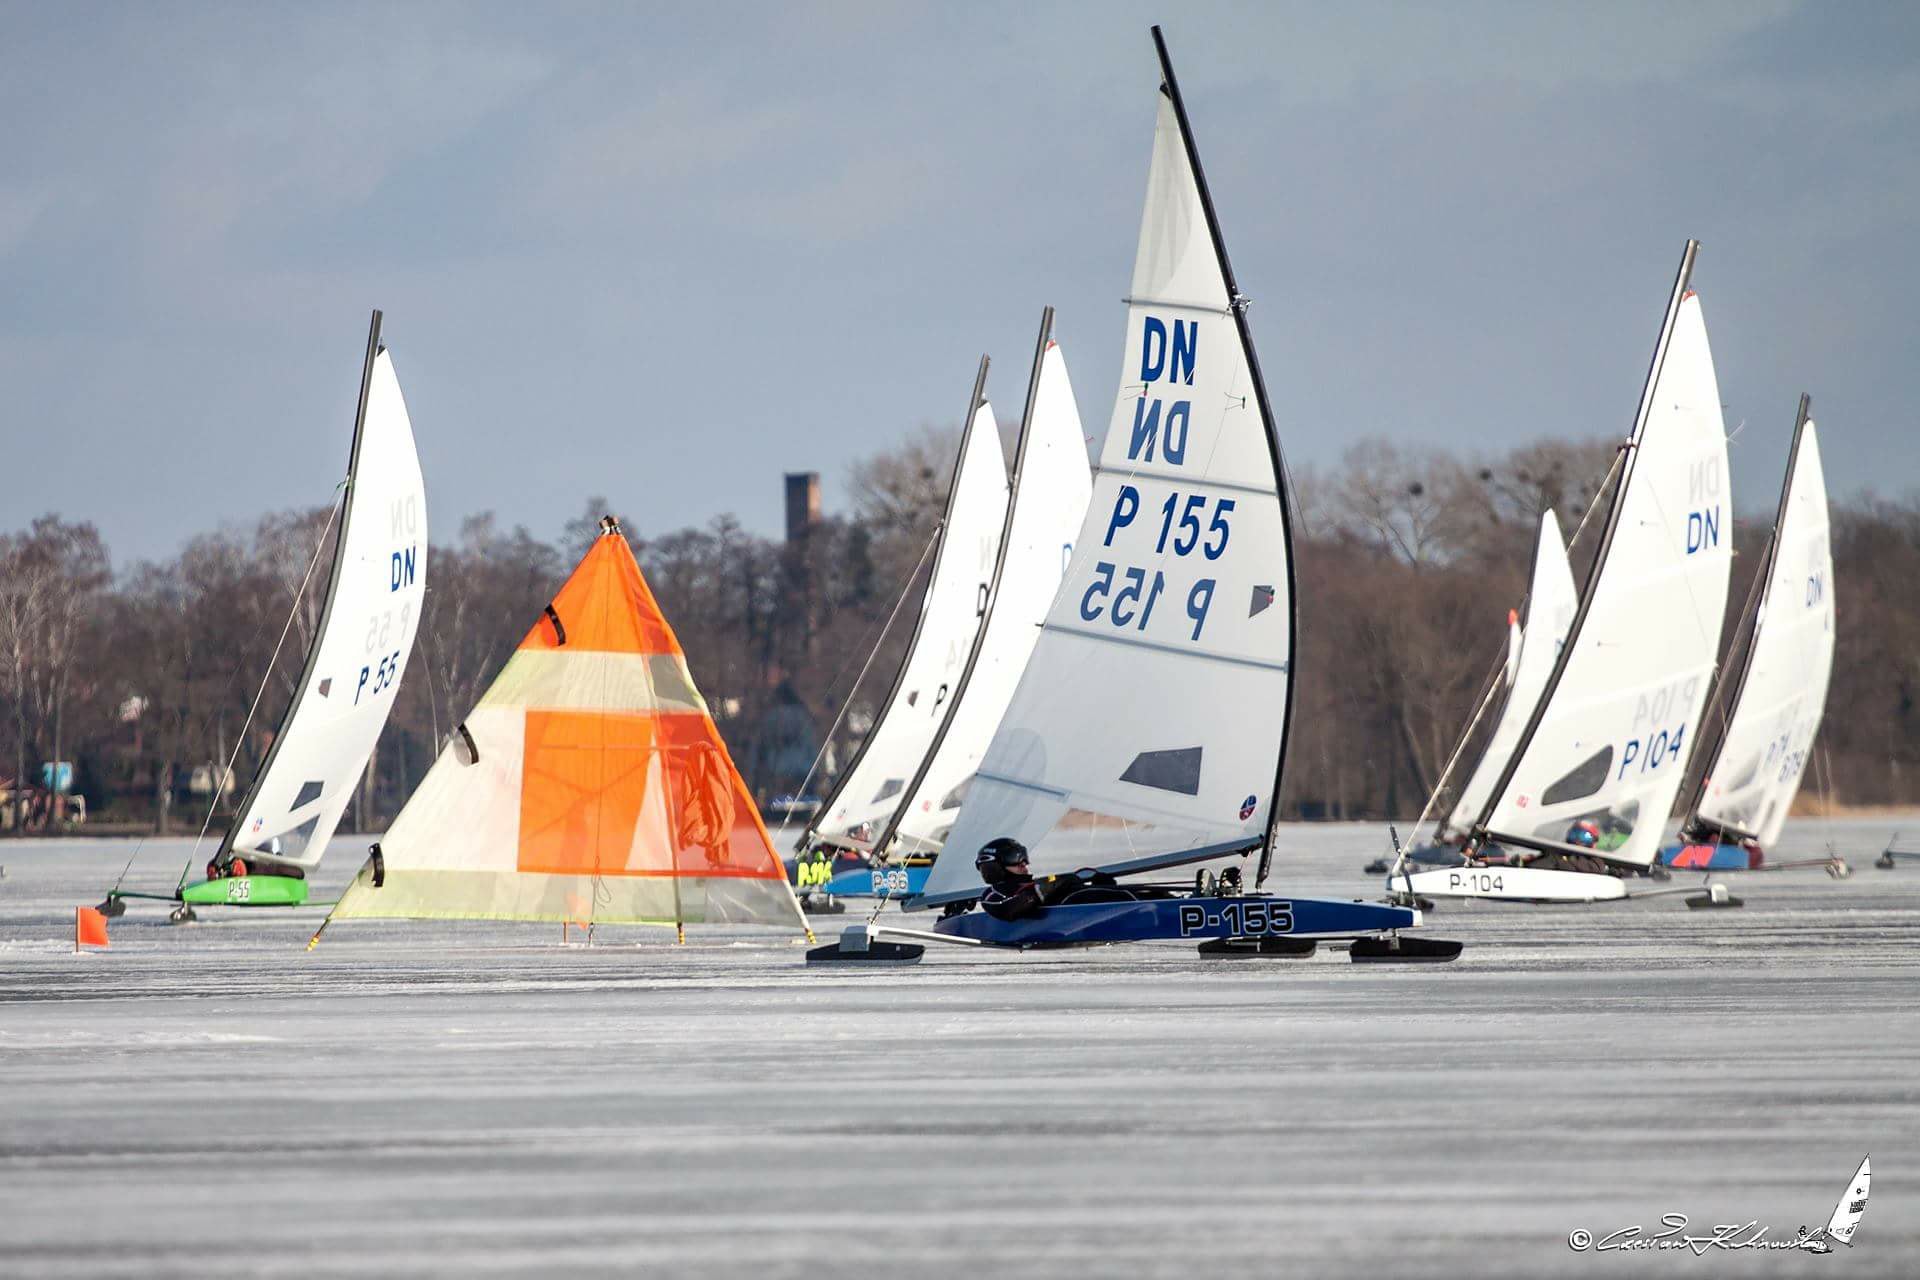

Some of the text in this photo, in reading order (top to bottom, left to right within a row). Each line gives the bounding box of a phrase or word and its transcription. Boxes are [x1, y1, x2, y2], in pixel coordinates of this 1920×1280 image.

[1140, 316, 1199, 386] DN
[1103, 485, 1236, 561] P 155
[1687, 505, 1719, 554] DN
[391, 546, 416, 592] DN
[354, 650, 400, 706] P 55
[1179, 901, 1295, 937] P-155
